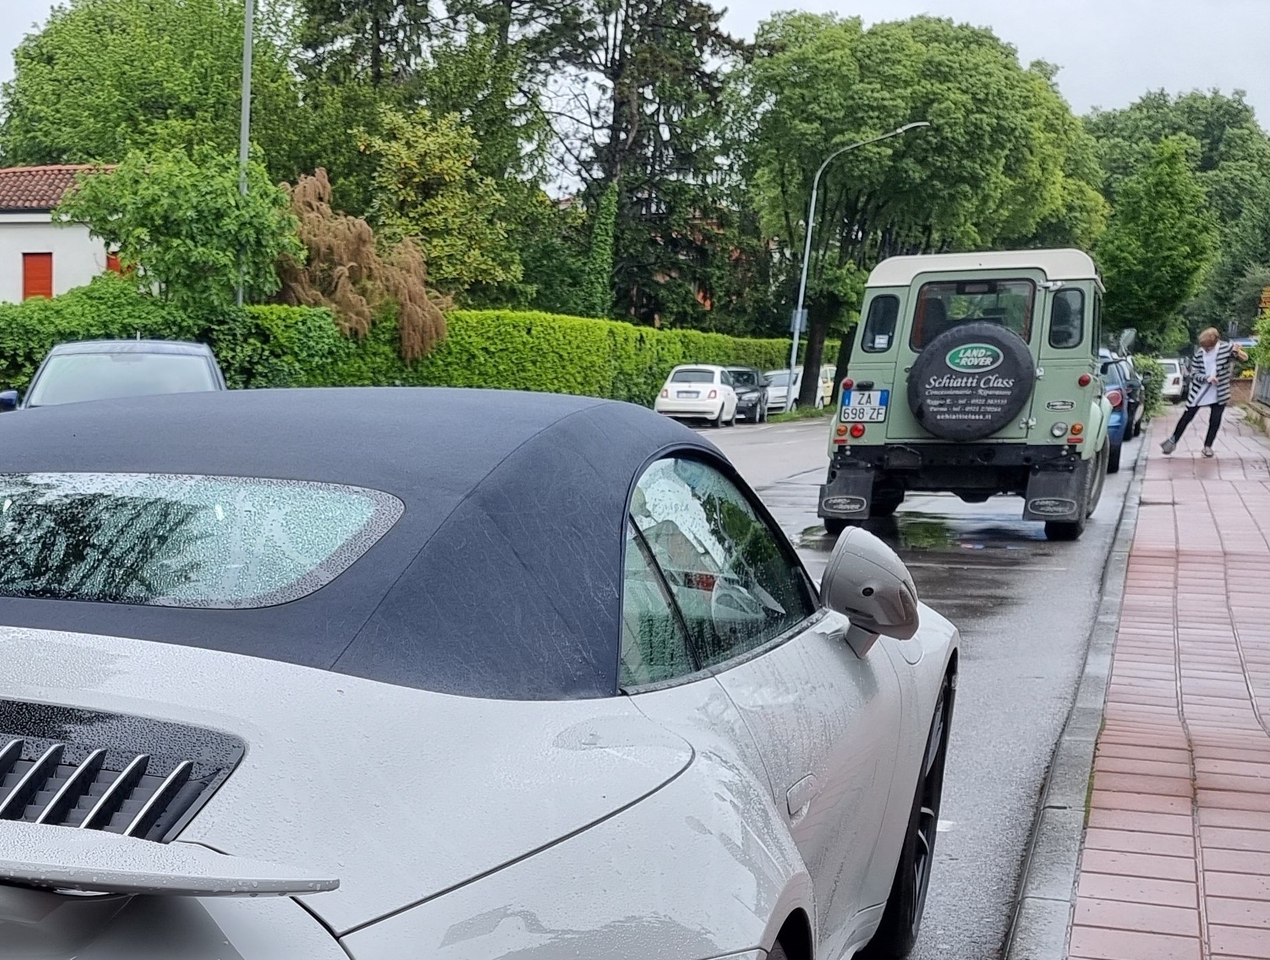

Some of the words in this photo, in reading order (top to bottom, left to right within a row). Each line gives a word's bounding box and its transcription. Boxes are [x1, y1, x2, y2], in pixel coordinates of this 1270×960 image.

[959, 349, 986, 357] LAND
[960, 357, 993, 365] ROVER
[925, 375, 978, 388] Schiatti
[980, 374, 1014, 388] Class
[858, 392, 872, 406] ZA
[843, 407, 865, 420] 698
[869, 407, 884, 420] ZF
